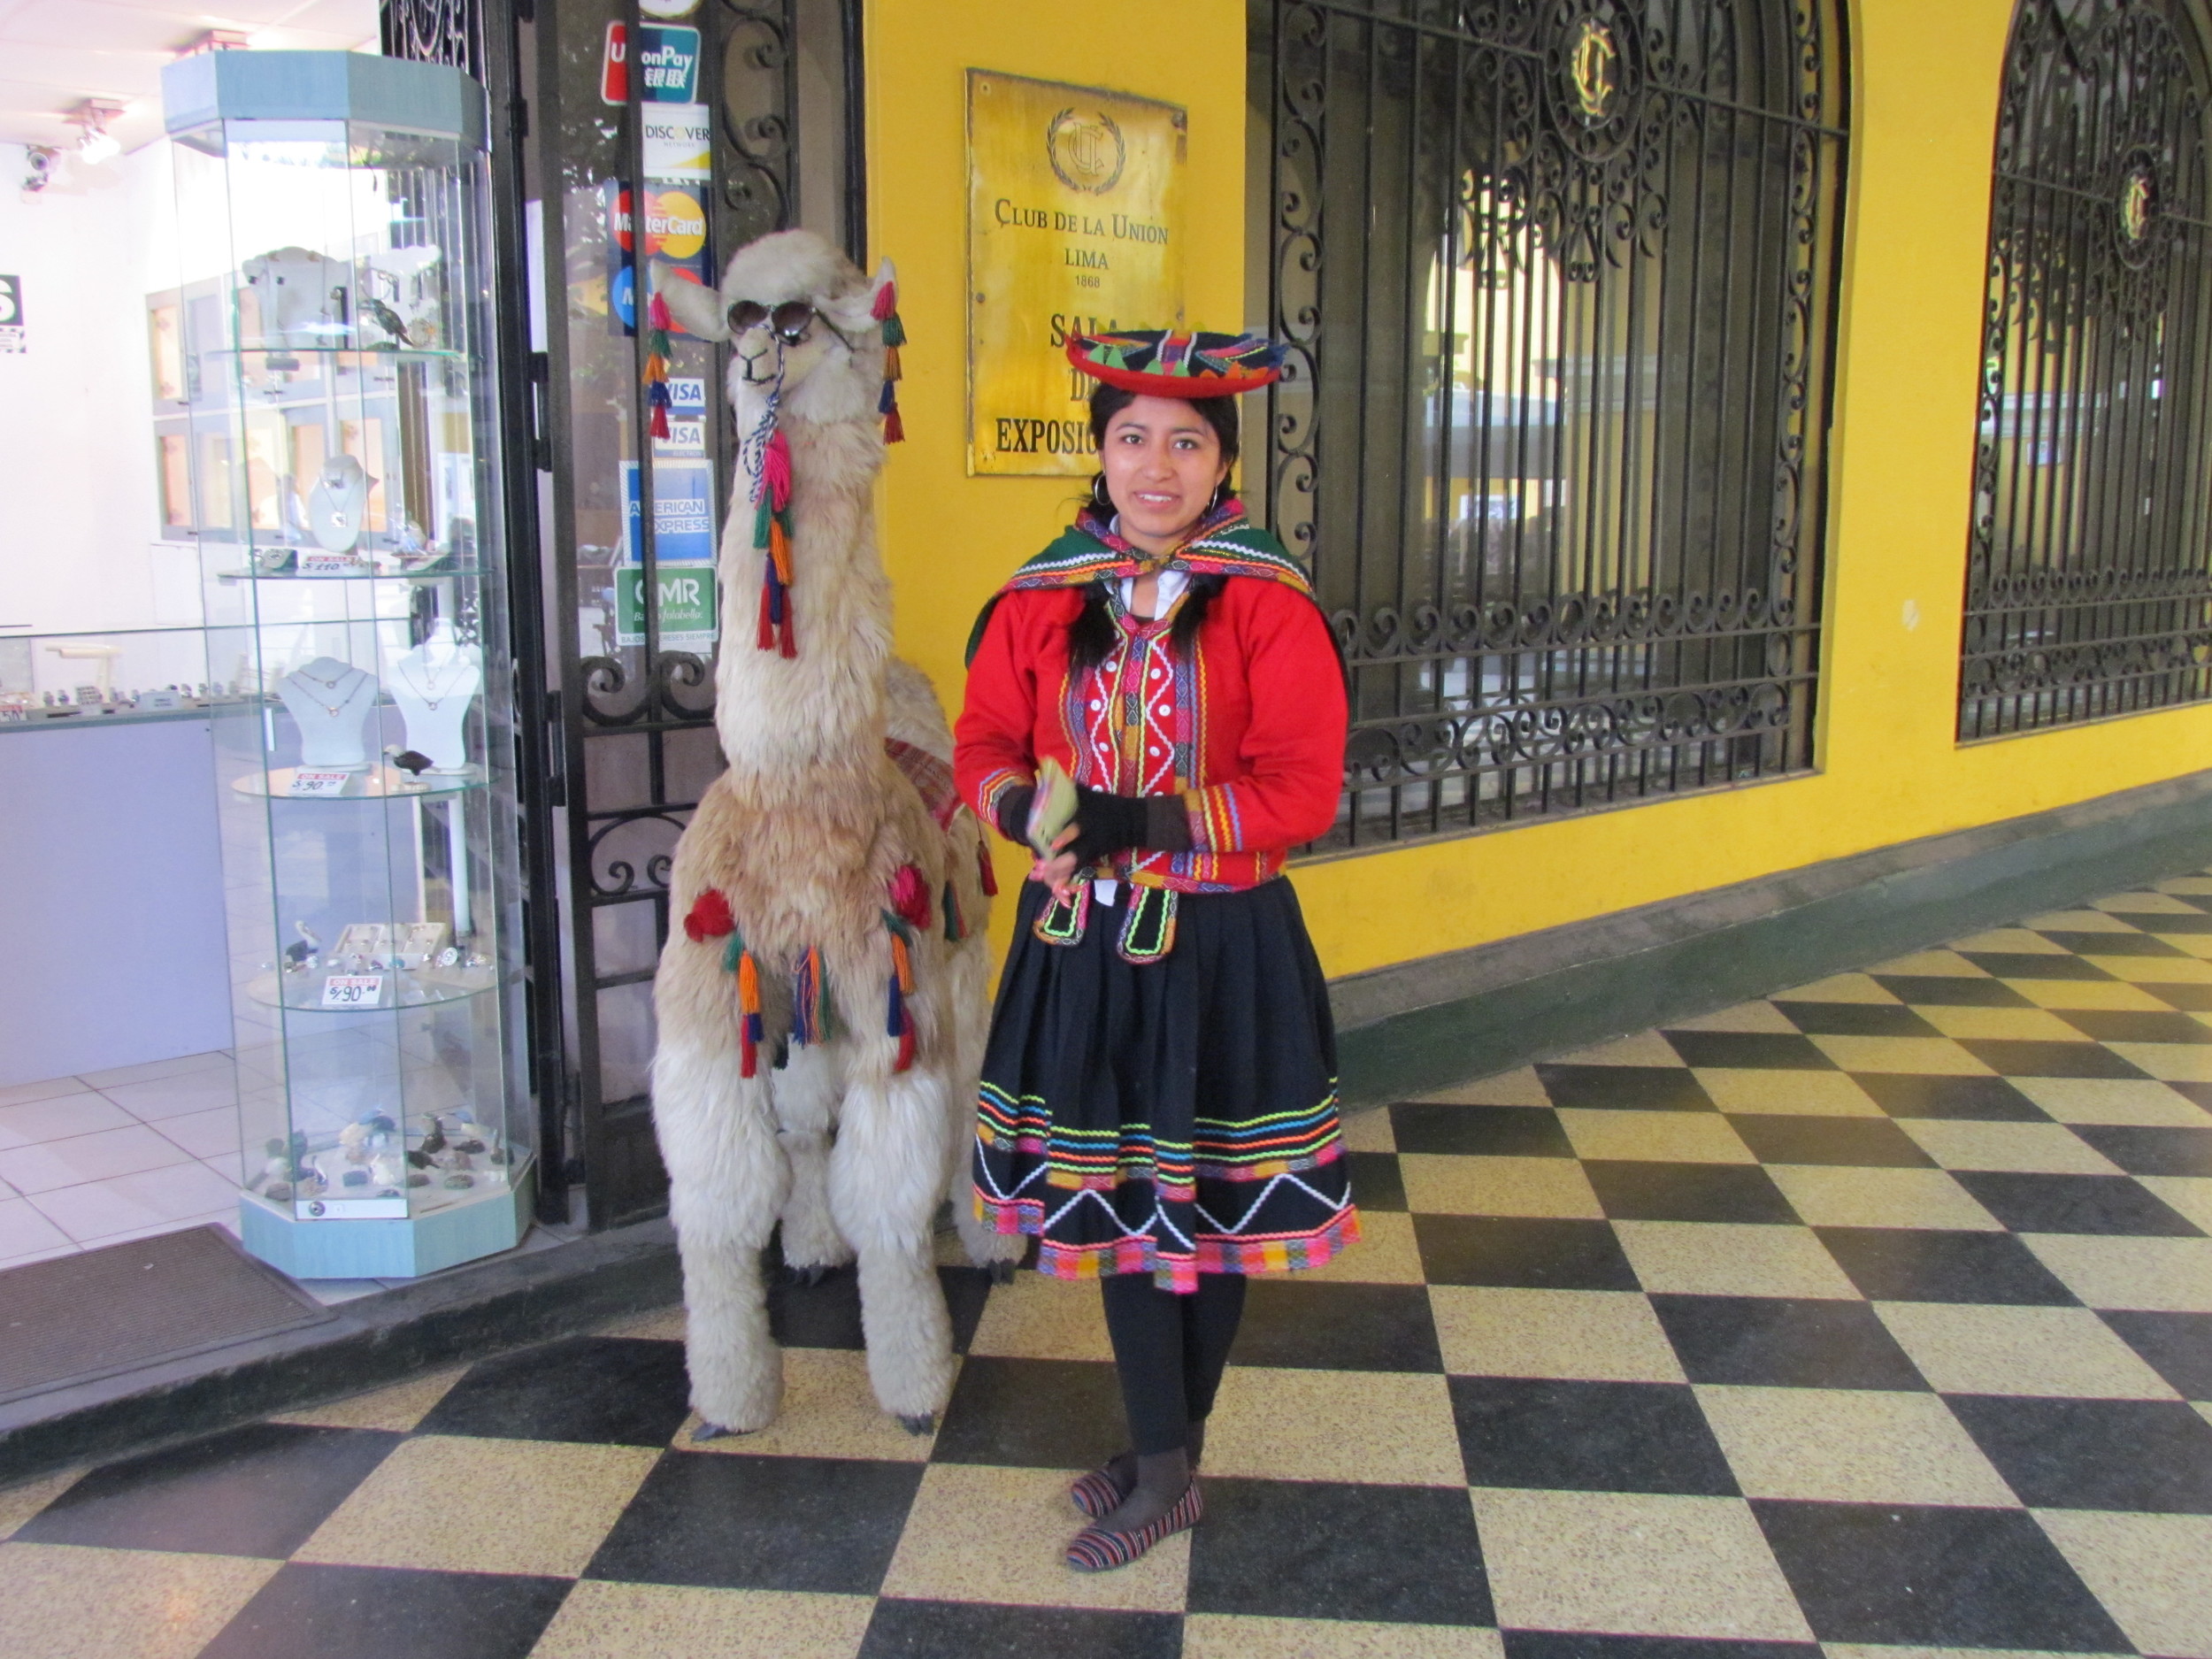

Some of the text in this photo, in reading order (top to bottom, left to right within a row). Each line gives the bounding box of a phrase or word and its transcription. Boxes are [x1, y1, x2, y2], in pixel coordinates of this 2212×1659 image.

[611, 42, 693, 74] UonPay
[645, 125, 710, 142] DISCOVER
[613, 212, 703, 235] MaterCard
[1064, 248, 1110, 270] LIMA
[1075, 275, 1101, 289] 1868
[630, 500, 703, 514] AERICAN
[655, 518, 710, 533] XPRESS
